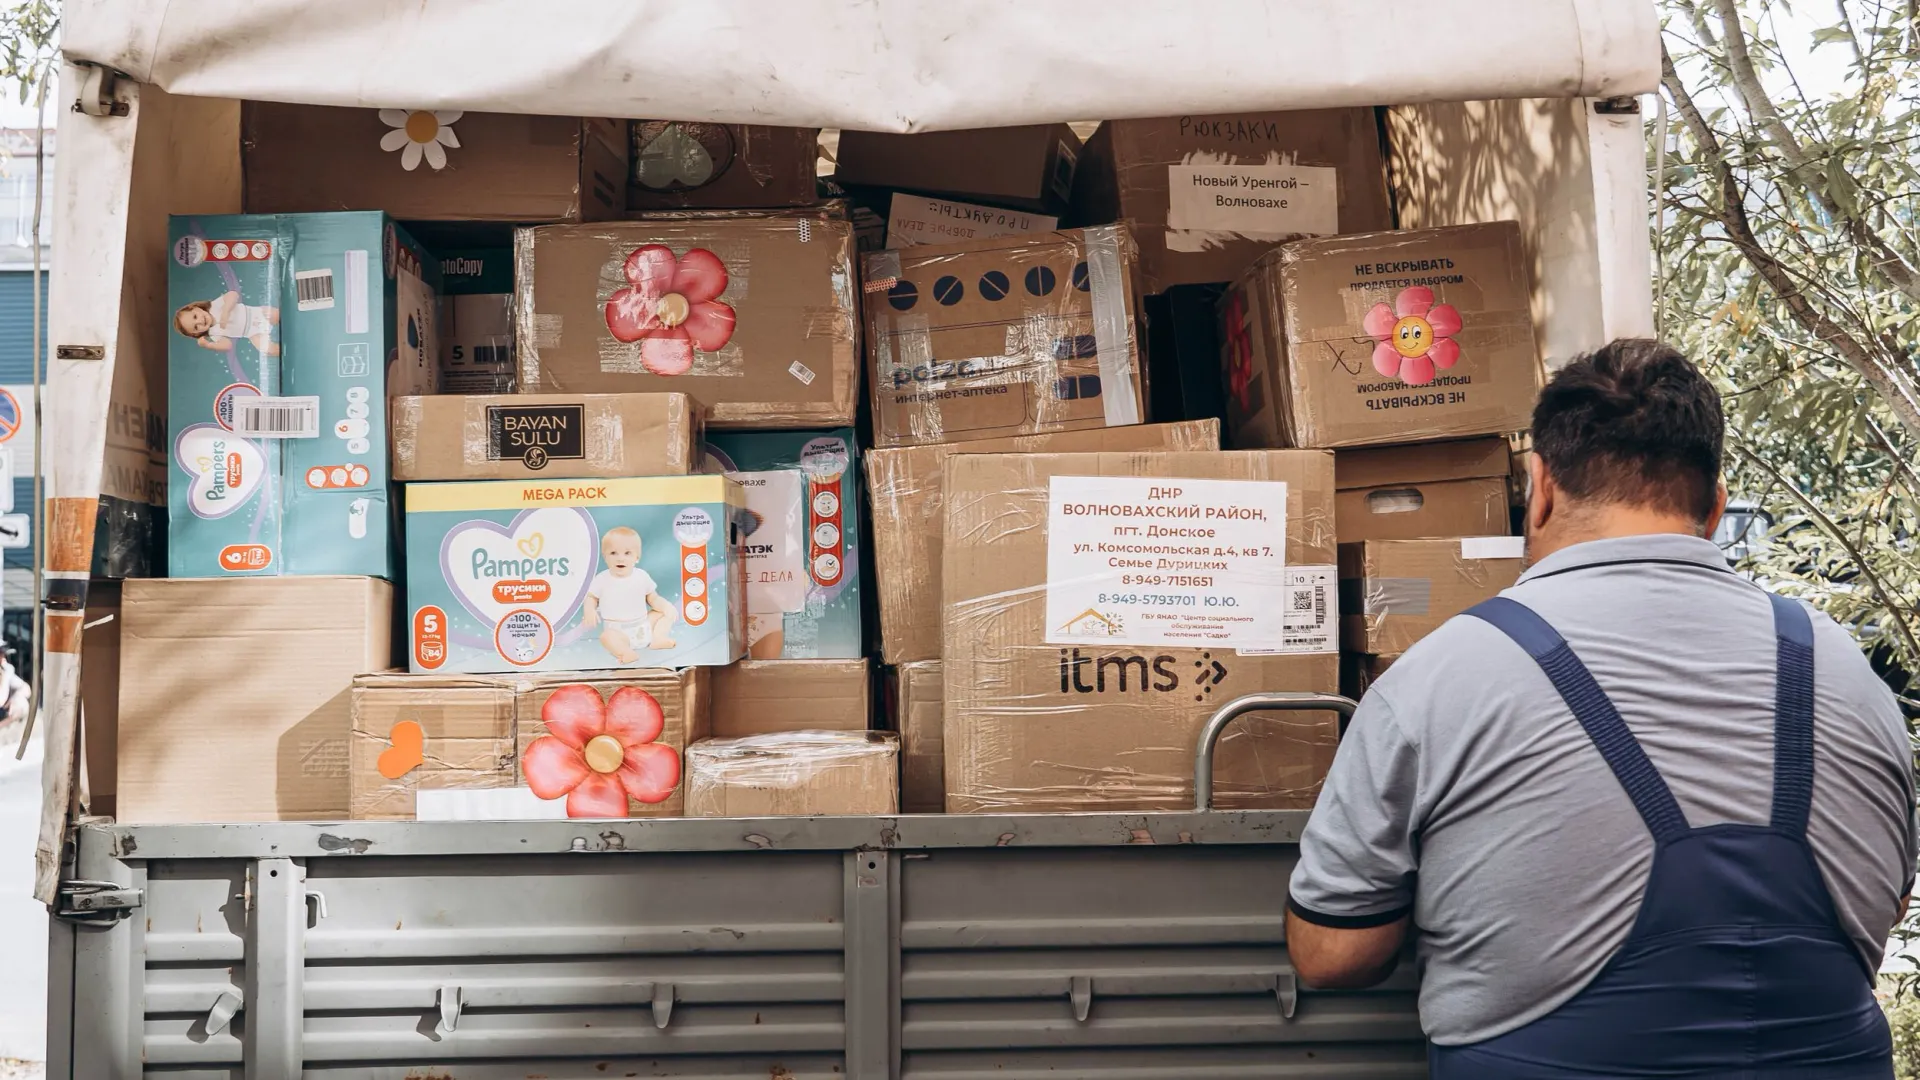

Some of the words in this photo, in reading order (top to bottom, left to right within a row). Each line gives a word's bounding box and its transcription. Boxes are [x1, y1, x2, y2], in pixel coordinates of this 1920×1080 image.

[1193, 174, 1238, 187] Новый
[1242, 175, 1298, 190] Уренгой
[1216, 194, 1288, 209] Волновахе
[1355, 263, 1373, 276] НЕ
[1376, 257, 1454, 274] ВСКРЫВАТЬ
[1350, 278, 1411, 292] ПРОДАЕТСЯ
[1413, 274, 1464, 289] НАБОРОМ
[1357, 380, 1409, 394] НАБОРОМ
[1366, 393, 1445, 410] ВСКРЫВАТЬ
[1449, 391, 1466, 404] НЕ
[504, 415, 566, 430] BAYAN
[511, 431, 560, 446] SULU
[205, 440, 226, 501] Pampers
[522, 488, 565, 501] MEGA
[568, 486, 607, 500] PACK
[1148, 486, 1183, 500] ДНР
[1063, 502, 1201, 519] ВОЛНОВАХСКИЙ
[1205, 505, 1268, 521] РАЙОН,
[1113, 526, 1142, 537] пгт.
[1147, 525, 1216, 539] Донское
[1073, 543, 1094, 555] ул.
[1097, 542, 1210, 556] Комсомольская
[1242, 547, 1259, 557] кв
[1262, 546, 1274, 557] 7.
[226, 552, 242, 564] 6
[471, 547, 569, 581] Pampers
[1108, 557, 1153, 569] Семье
[1156, 558, 1229, 571] Дурицких
[758, 570, 794, 583] ДЕЛА
[1122, 574, 1214, 588] 8-949-7151651
[1294, 576, 1305, 584] 10
[497, 583, 546, 596] трусики
[1098, 593, 1196, 607] 8-949-5793701
[1204, 596, 1240, 608] Ю.Ю.
[424, 614, 438, 633] 5
[1141, 613, 1156, 621] ГБУ
[1207, 615, 1254, 624] социального
[1060, 647, 1179, 693] itms
